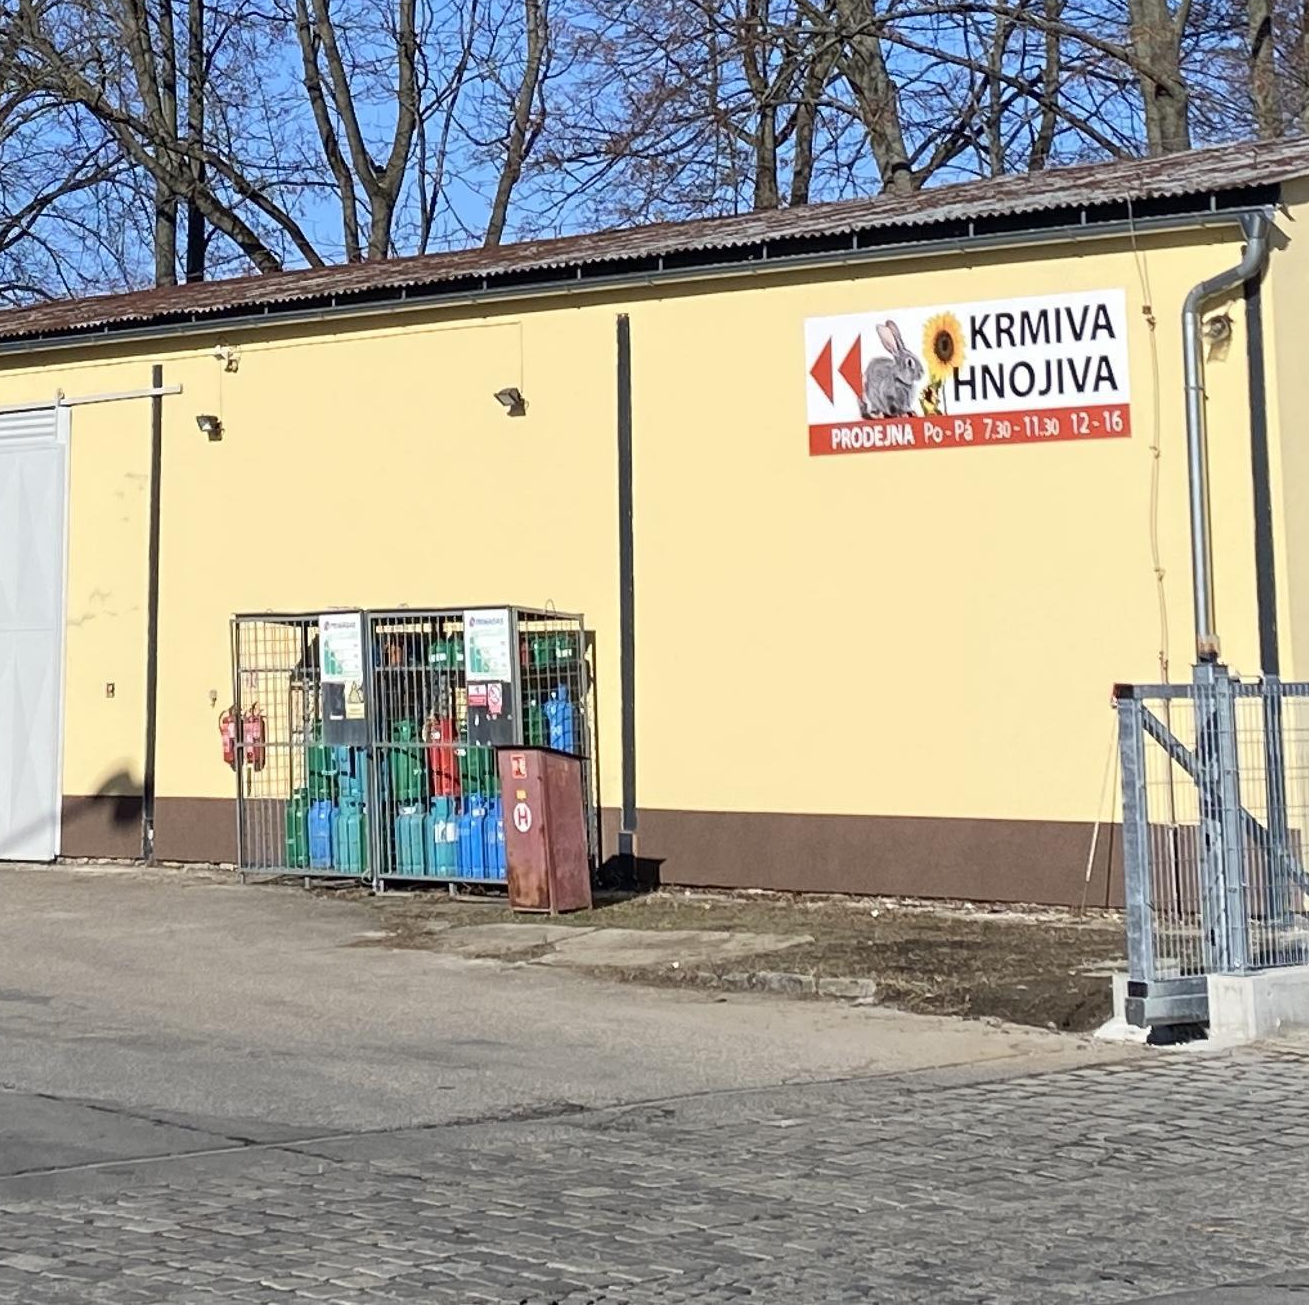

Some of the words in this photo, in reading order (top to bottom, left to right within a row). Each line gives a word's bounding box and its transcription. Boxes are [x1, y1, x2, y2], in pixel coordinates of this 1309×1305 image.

[969, 303, 1116, 350] KRMIVA
[953, 354, 1119, 401] HNOJIVA
[831, 423, 915, 450] PRODEJNA
[518, 808, 529, 826] H
